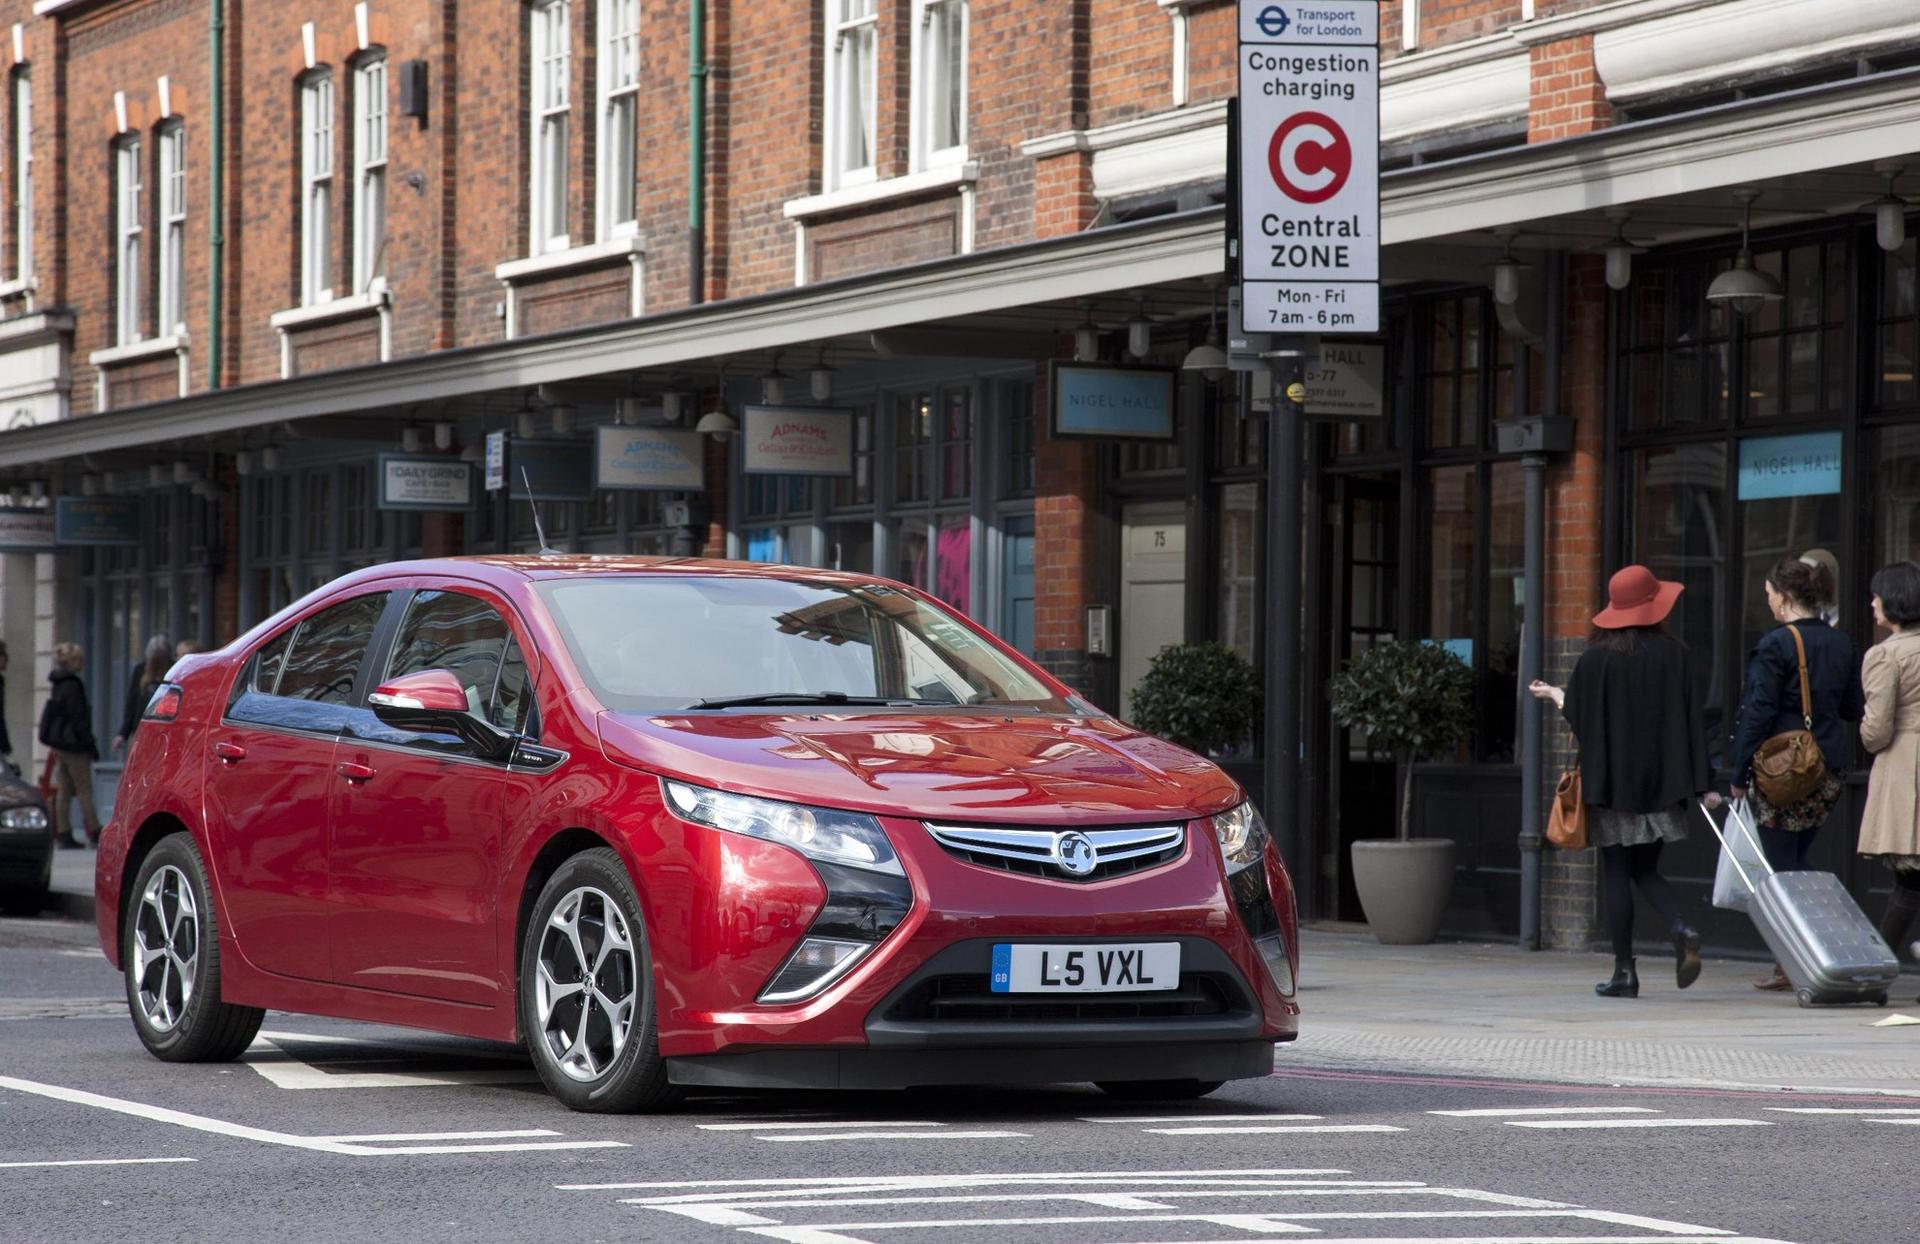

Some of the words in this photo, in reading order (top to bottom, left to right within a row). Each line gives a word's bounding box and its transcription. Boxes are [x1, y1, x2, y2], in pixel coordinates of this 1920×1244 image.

[1296, 8, 1356, 22] Transport
[1296, 23, 1314, 36] for
[1317, 24, 1362, 36] London
[1248, 51, 1369, 75] Congestion
[1263, 77, 1355, 100] charging
[1261, 213, 1361, 238] Central
[1271, 245, 1350, 268] ZONE
[1278, 289, 1311, 303] Mon
[1325, 289, 1345, 303] Fri
[1325, 350, 1366, 365] HALL
[1068, 393, 1116, 408] NIGEL
[1122, 395, 1161, 410] HALL
[771, 422, 828, 441] ADNAMS
[1752, 456, 1797, 477] NIGEL
[1803, 453, 1841, 473] HALL
[1154, 530, 1166, 548] 75
[1041, 951, 1085, 987] L5
[1097, 949, 1154, 986] VXL
[994, 972, 1008, 983] GB
